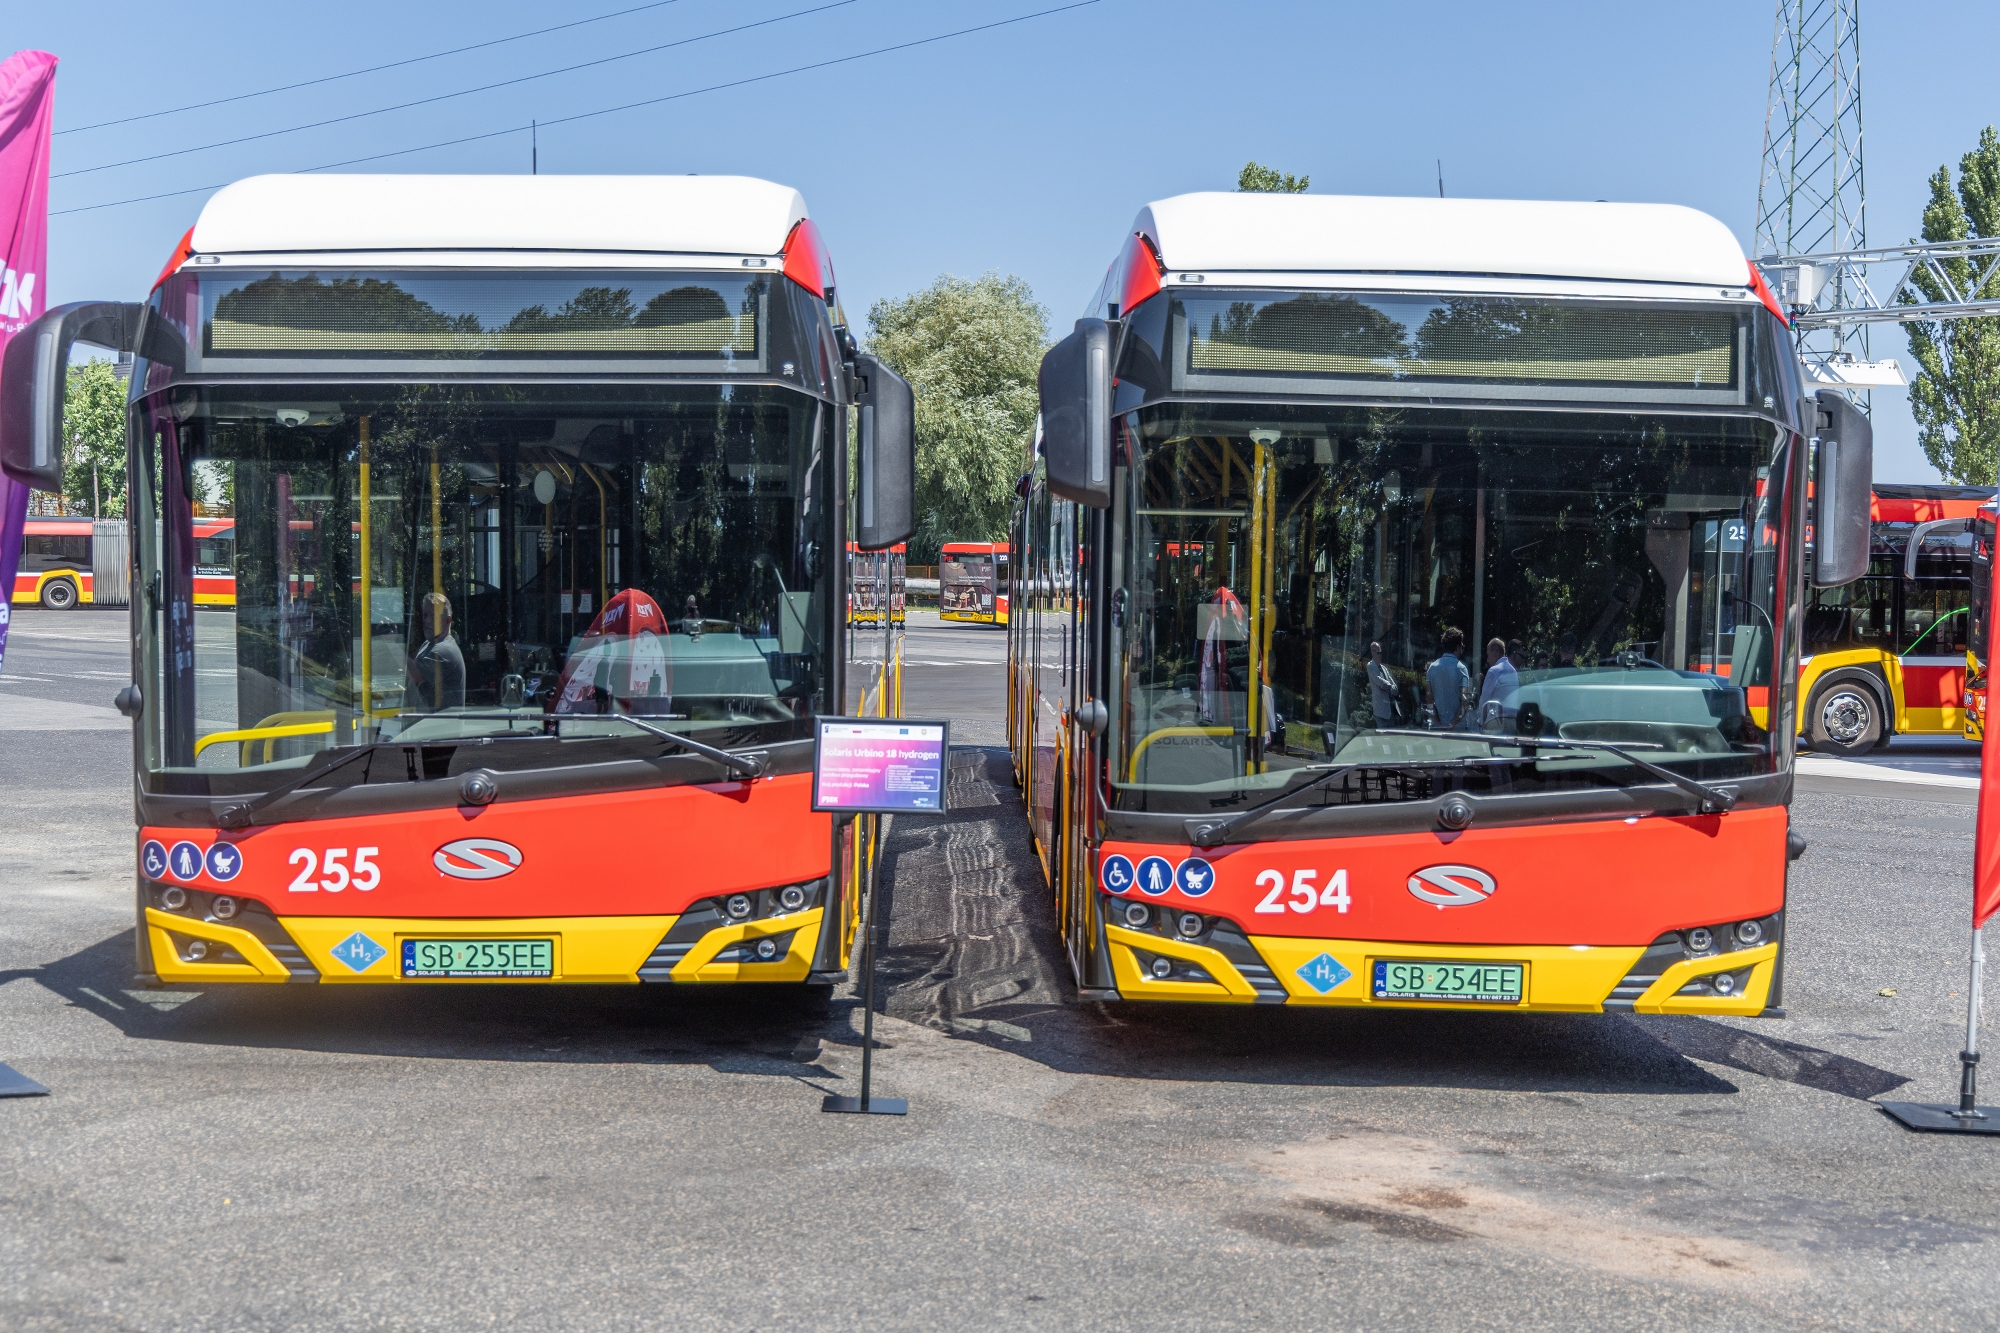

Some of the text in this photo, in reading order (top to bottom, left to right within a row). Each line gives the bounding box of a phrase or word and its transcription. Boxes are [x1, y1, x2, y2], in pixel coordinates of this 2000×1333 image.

[1153, 737, 1214, 746] SOLARIS
[823, 748, 939, 761] Solaris Urbino 18 hydrogen
[288, 846, 381, 892] 255
[1254, 869, 1352, 914] 254
[405, 959, 415, 967] PL
[422, 944, 546, 968] SB 255EE
[1375, 979, 1385, 988] PL
[1392, 965, 1516, 993] SB 254EE
